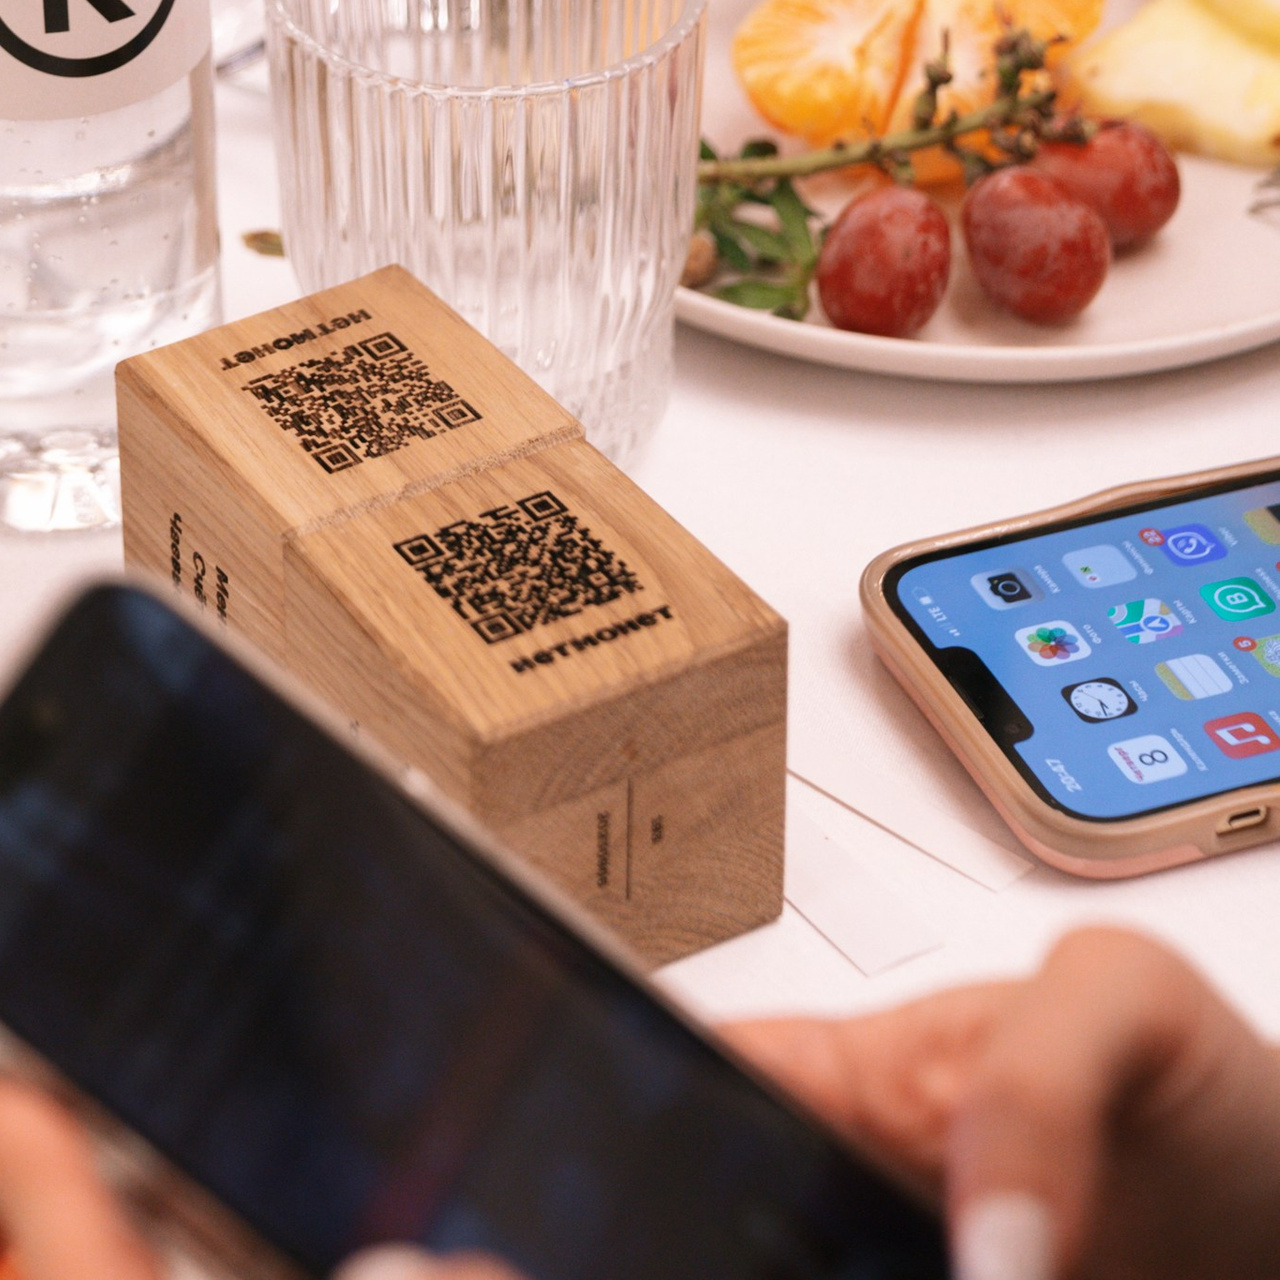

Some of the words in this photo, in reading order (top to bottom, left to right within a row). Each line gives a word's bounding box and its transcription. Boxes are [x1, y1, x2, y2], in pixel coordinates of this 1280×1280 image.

[1143, 530, 1162, 544] 22
[1033, 564, 1060, 594] Камера
[927, 606, 948, 623] LTE
[1172, 599, 1198, 624] Карты
[1082, 624, 1102, 645] Фото
[1129, 680, 1148, 702] Часы
[1138, 749, 1169, 766] 8
[1044, 758, 1083, 793] 20:47
